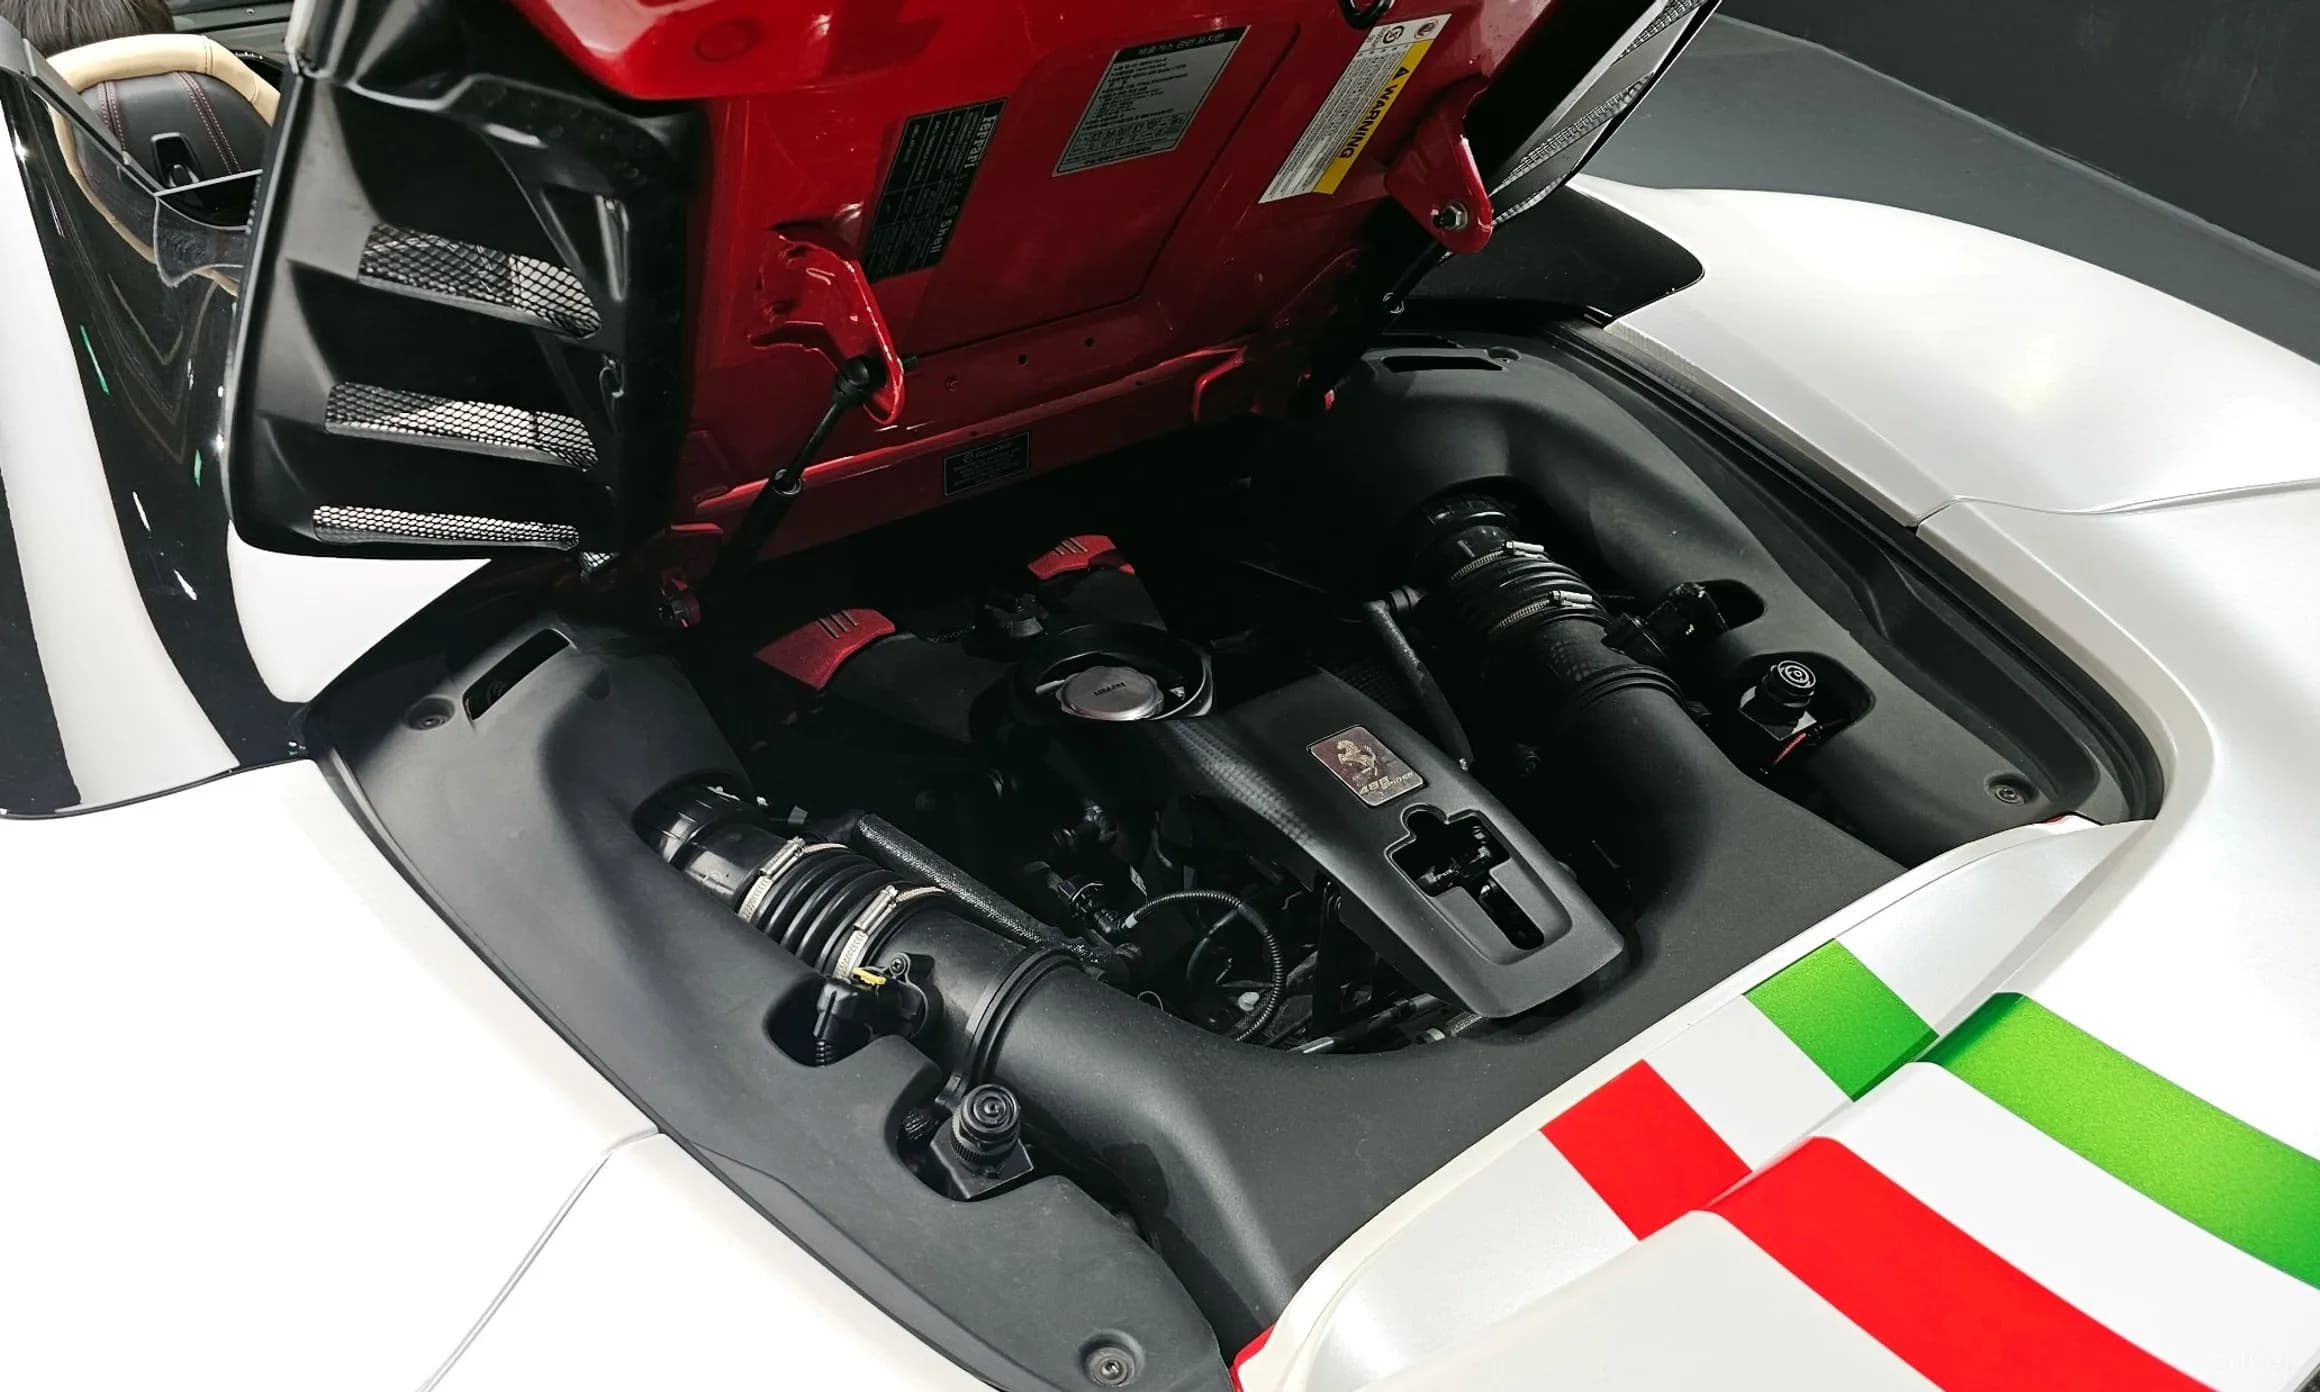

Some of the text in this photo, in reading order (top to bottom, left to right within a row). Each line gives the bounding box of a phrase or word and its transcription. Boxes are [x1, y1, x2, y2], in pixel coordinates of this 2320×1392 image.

[964, 114, 998, 168] Ferrari
[1339, 84, 1399, 159] WARNING
[929, 219, 950, 254] Shell
[1359, 775, 1390, 795] 488
